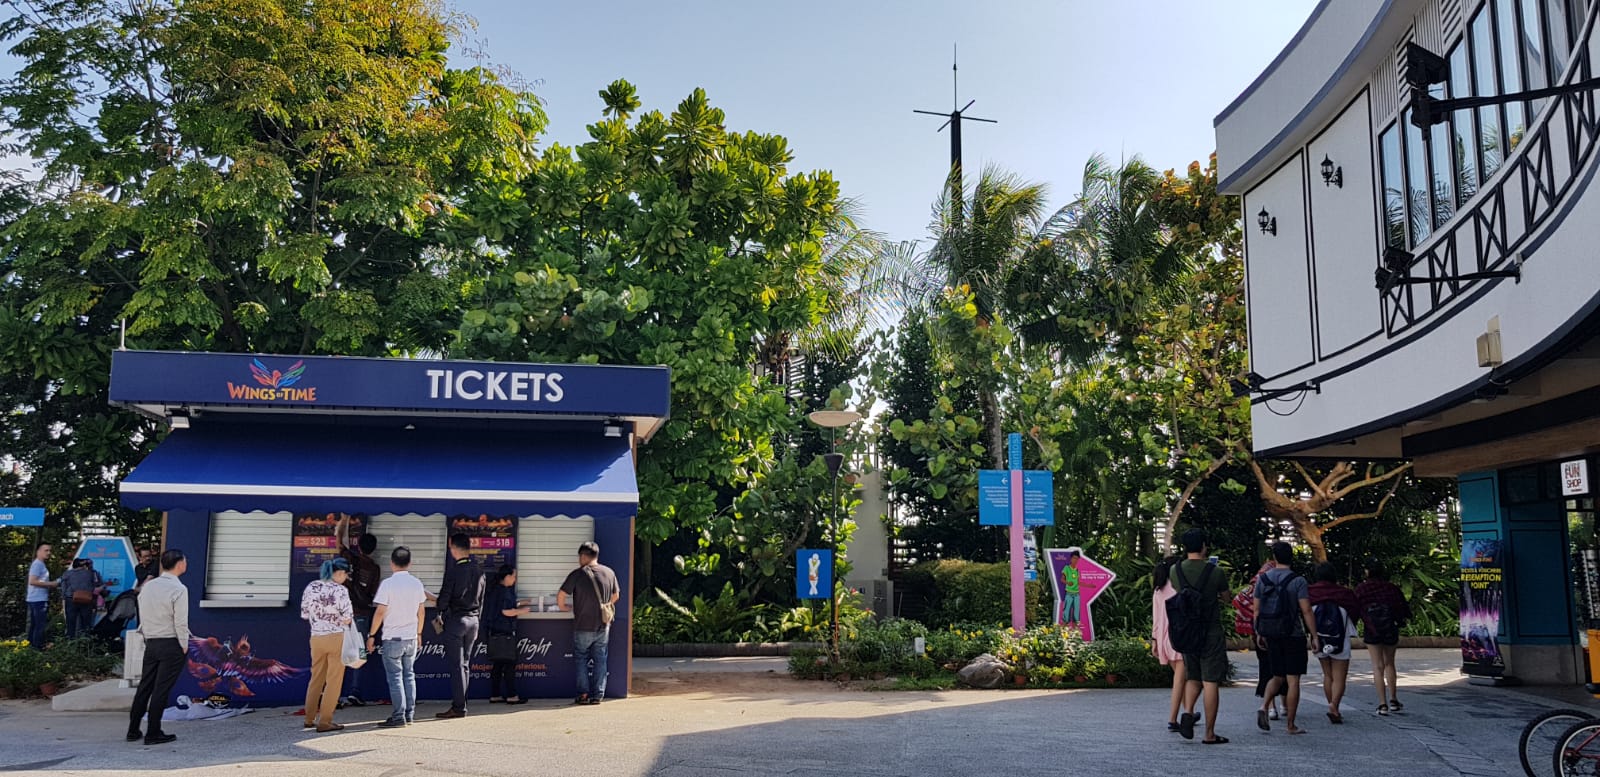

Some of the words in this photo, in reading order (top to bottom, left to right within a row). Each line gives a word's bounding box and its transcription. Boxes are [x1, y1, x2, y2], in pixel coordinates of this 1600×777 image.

[227, 382, 275, 400] WINGS
[281, 387, 316, 401] TIME
[426, 369, 564, 402] TICKETS
[1566, 479, 1581, 488] SHOP
[469, 538, 480, 547] 23
[517, 638, 552, 660] flight
